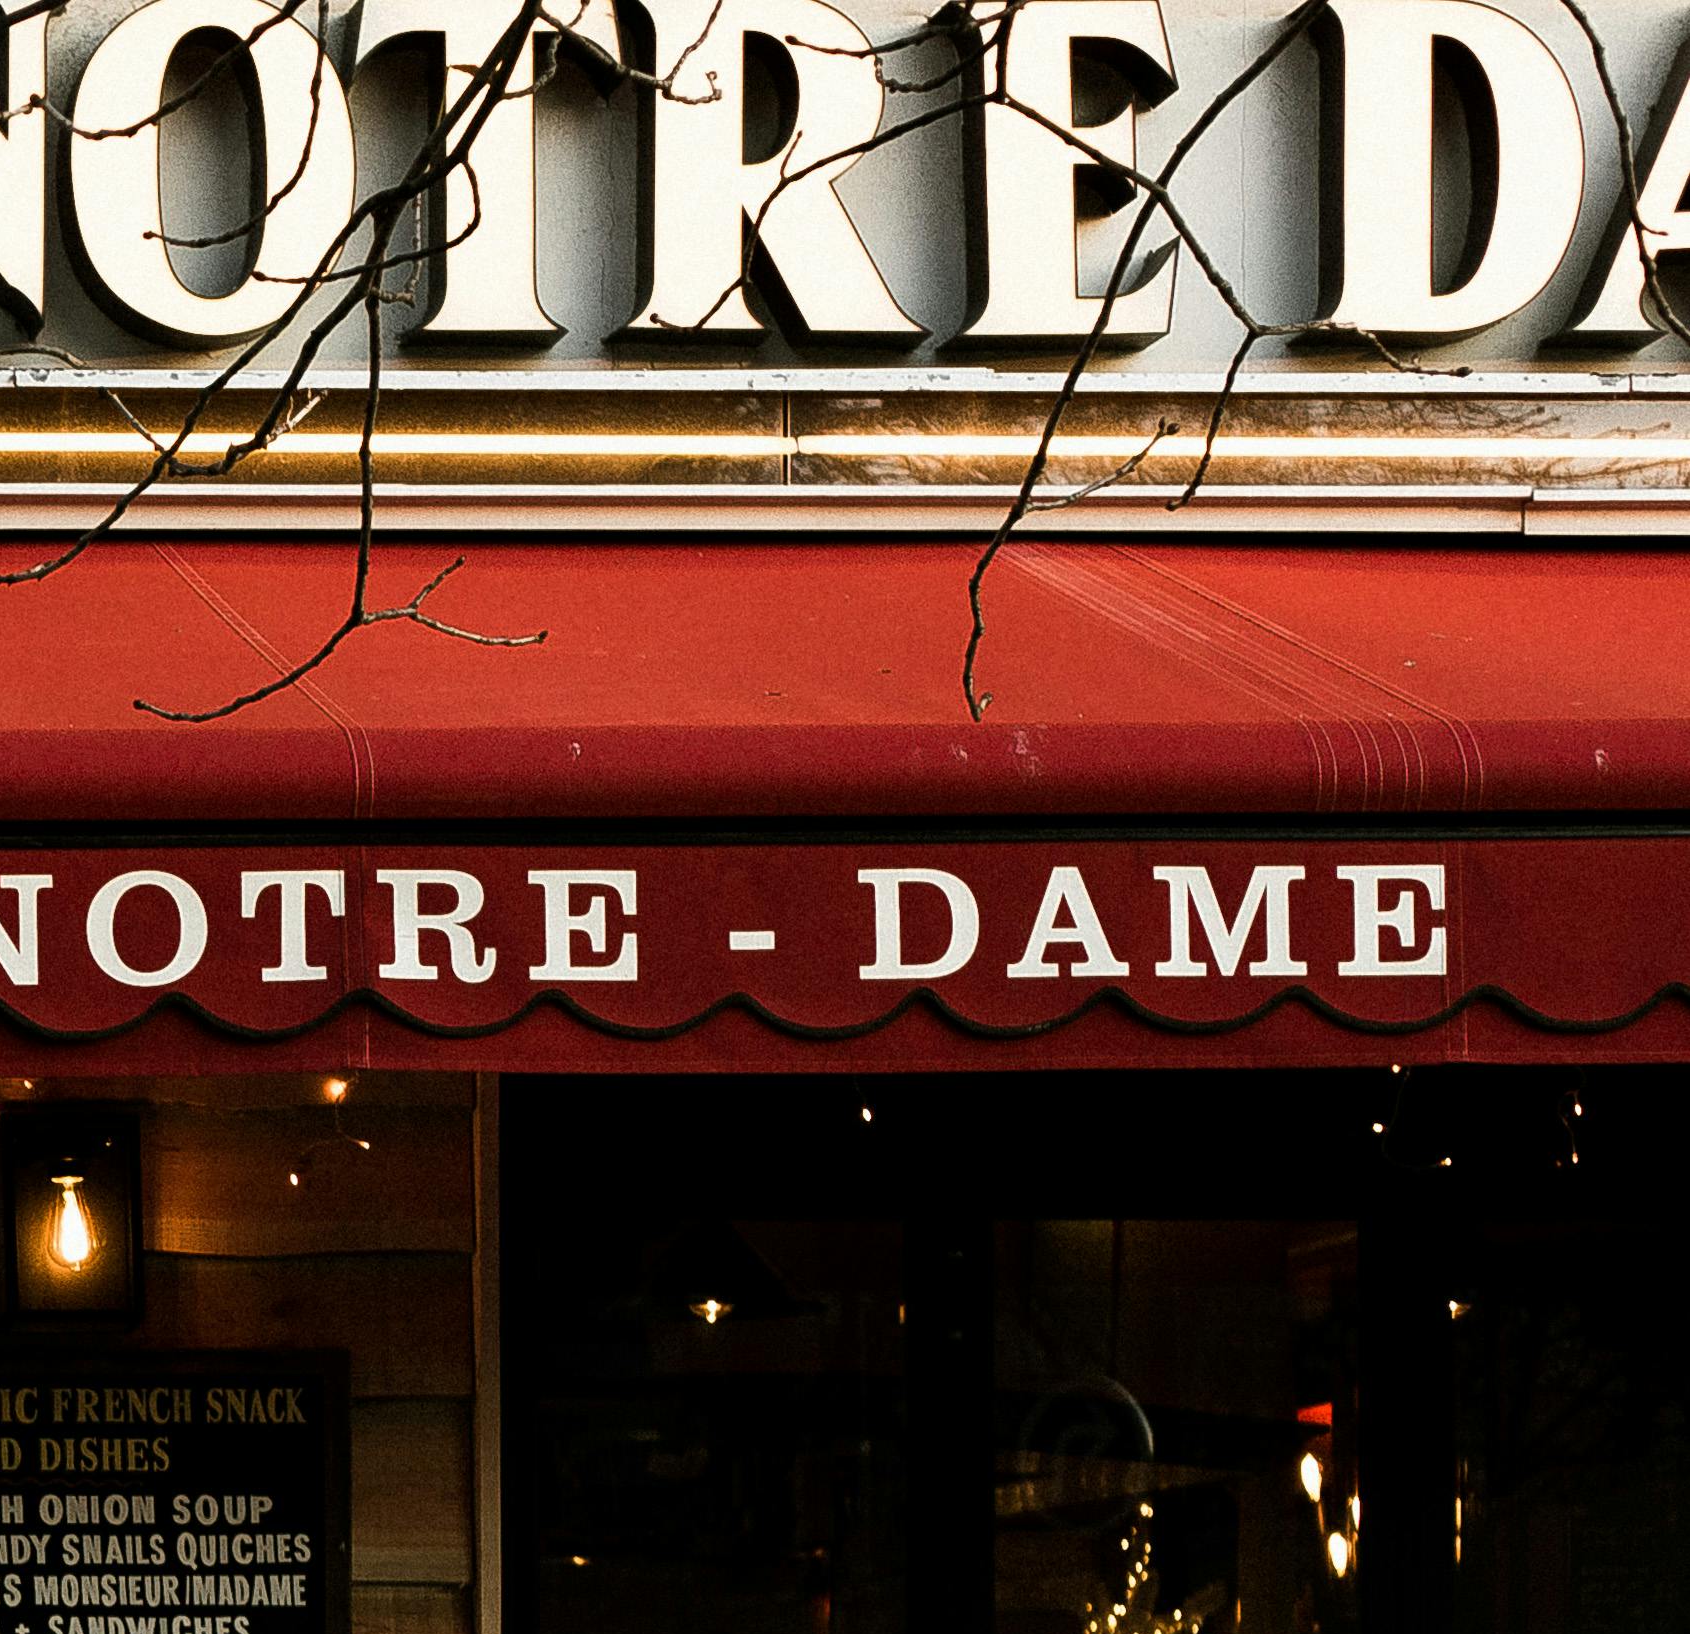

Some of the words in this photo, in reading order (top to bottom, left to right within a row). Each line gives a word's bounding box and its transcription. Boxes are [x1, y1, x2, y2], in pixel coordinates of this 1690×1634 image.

[857, 864, 1447, 977] DAME
[52, 1387, 192, 1425] FRENCH
[206, 1387, 306, 1424] SNACK
[39, 1437, 170, 1472] DISHES
[38, 1493, 156, 1526] ONION
[172, 1494, 273, 1526] SOUP
[61, 1533, 166, 1566] SNAILS
[176, 1531, 312, 1571] QUICHES
